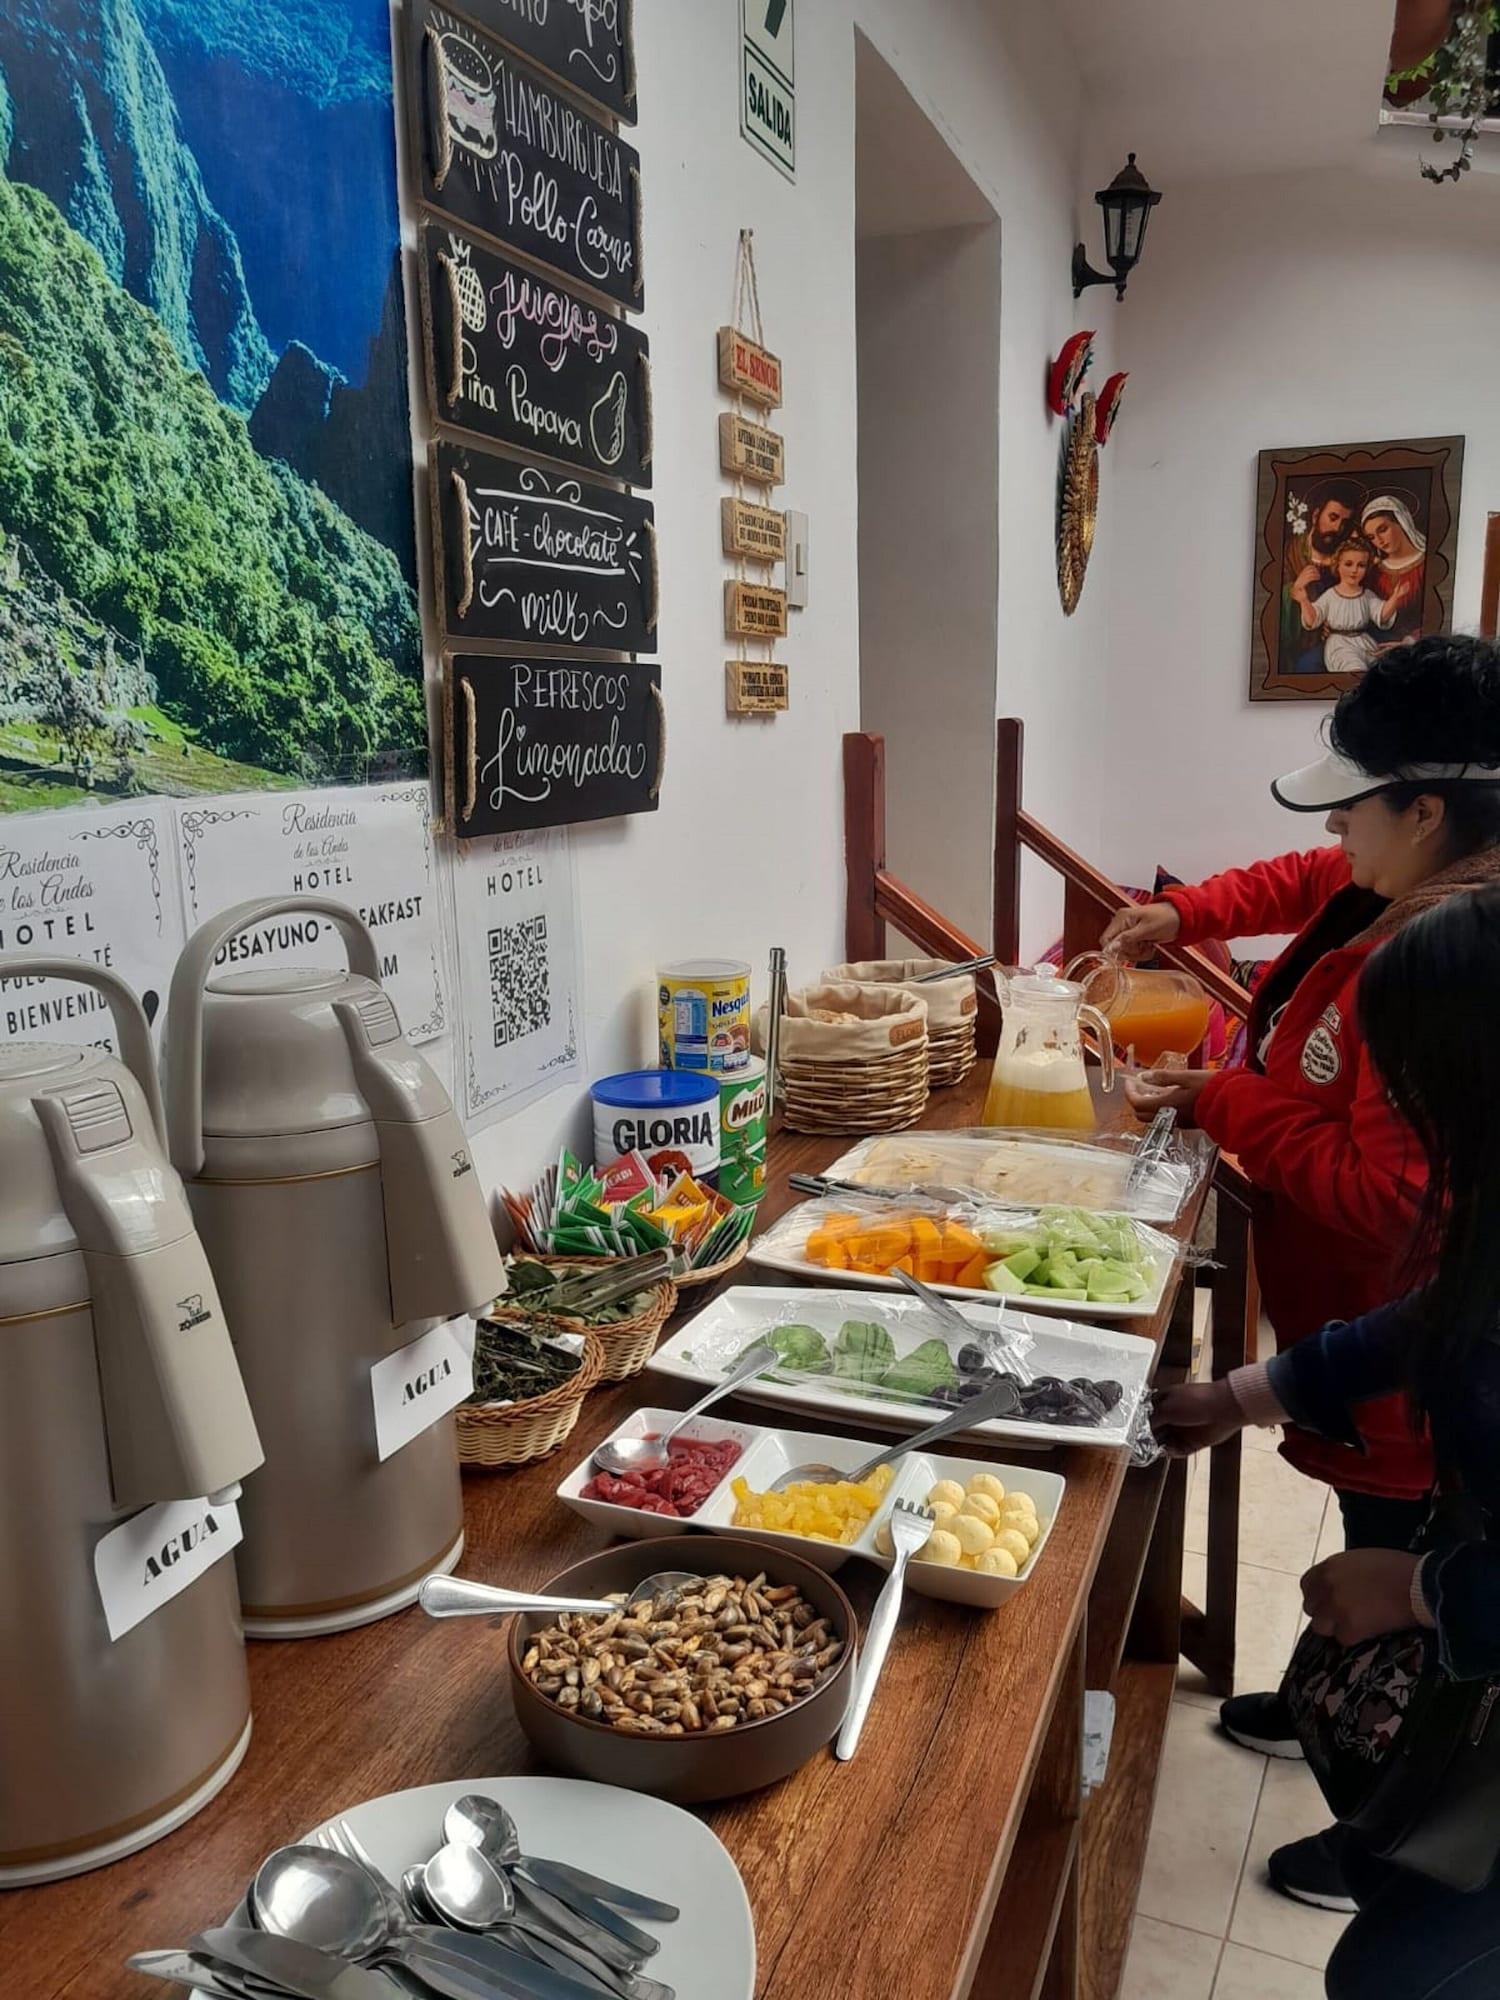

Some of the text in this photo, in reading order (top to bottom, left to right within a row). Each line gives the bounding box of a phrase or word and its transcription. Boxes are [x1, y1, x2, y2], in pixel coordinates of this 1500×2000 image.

[502, 63, 622, 203] HAMBURGUESA
[749, 72, 792, 149] SALIDA
[490, 271, 618, 372] Jugos
[460, 338, 583, 448] Piña Papaya
[485, 506, 520, 552] CAFÉ
[533, 512, 623, 567] chocolate
[510, 664, 629, 711] REFRESCOS
[481, 708, 646, 810] Limonada
[282, 803, 356, 835] Residencia
[0, 851, 79, 880] Residencia
[294, 866, 352, 892] HOTEL
[487, 865, 543, 896] HOTEL
[12, 886, 33, 910] las
[40, 873, 93, 906] Andes
[214, 920, 320, 966] DESAYUNO
[7, 990, 107, 1034] BIENVENID
[613, 1111, 713, 1154] GLORIA
[402, 1358, 451, 1406] AGUA
[144, 1514, 218, 1586] AGUA
